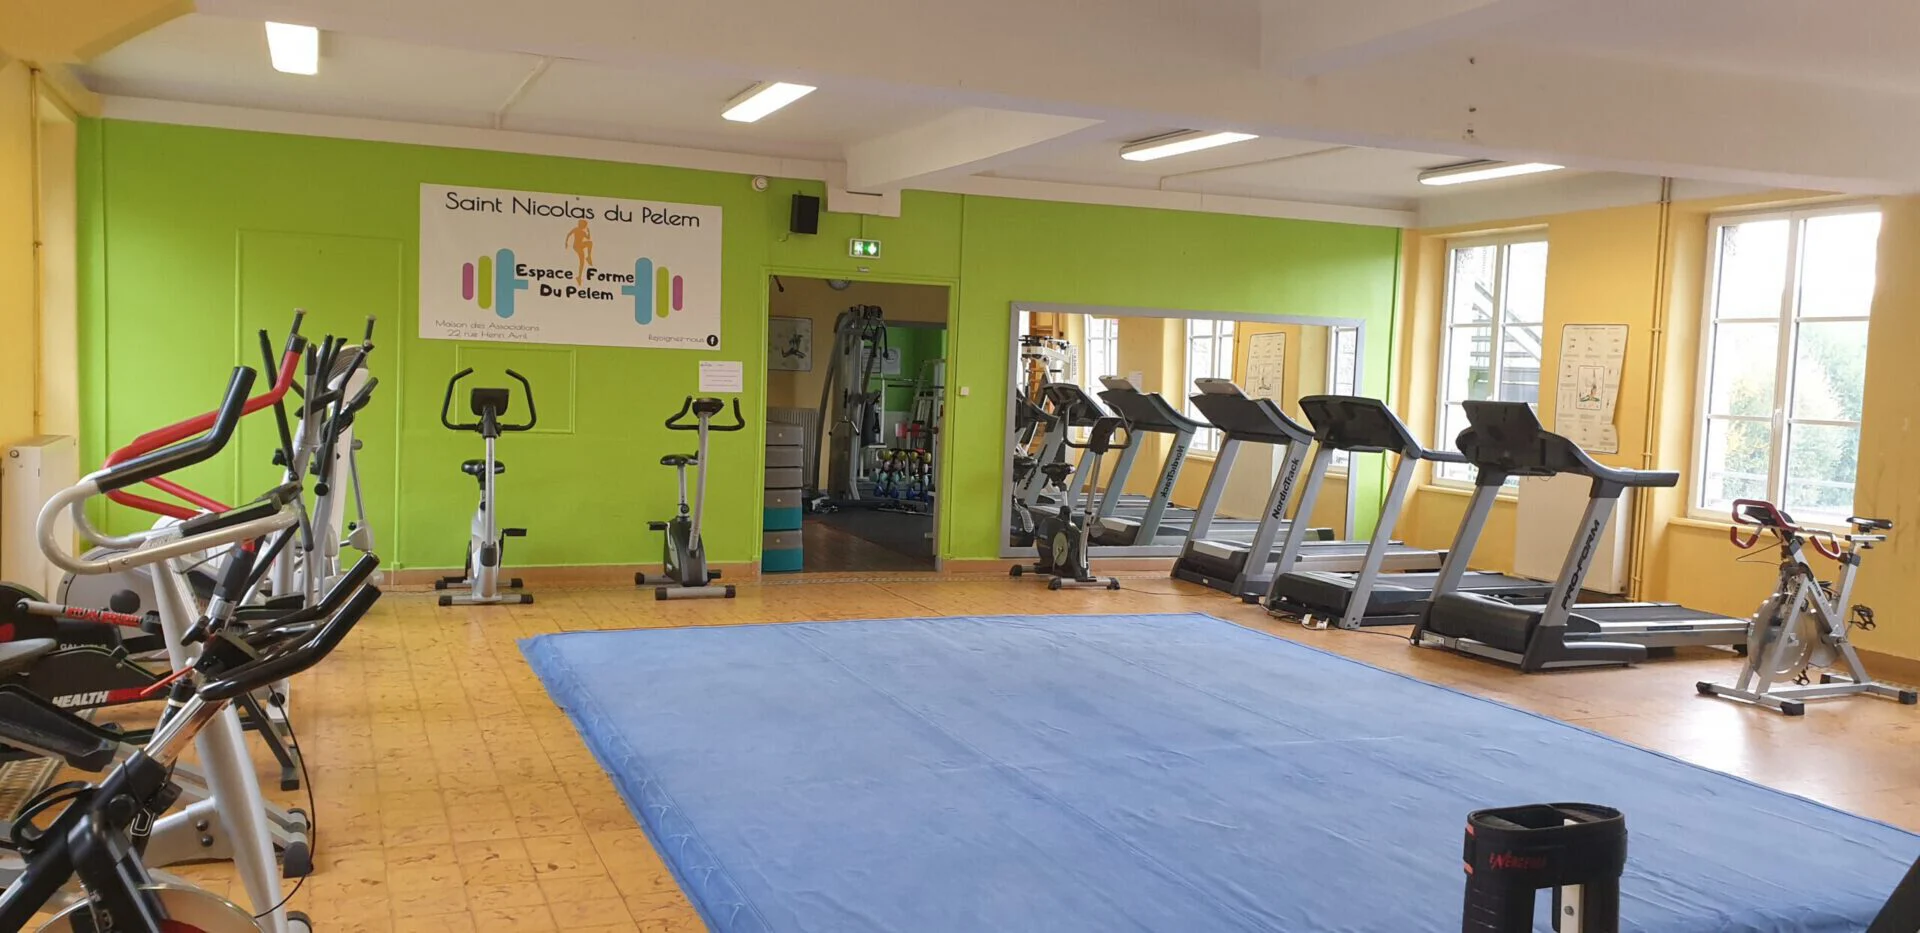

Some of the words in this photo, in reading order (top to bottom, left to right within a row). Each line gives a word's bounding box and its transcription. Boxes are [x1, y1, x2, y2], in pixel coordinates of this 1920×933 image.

[446, 191, 502, 213] Saint
[513, 196, 595, 219] Nicolas
[604, 204, 632, 222] du
[643, 206, 700, 227] Pelem
[515, 263, 573, 281] Espace
[586, 268, 634, 283] Forme
[540, 283, 562, 298] Du
[566, 286, 613, 300] Pelem
[435, 319, 468, 328] Maison
[471, 321, 486, 329] des
[489, 321, 540, 331] Associations
[447, 328, 461, 337] 22
[1271, 457, 1300, 520] NordicTrack
[52, 690, 110, 708] HEALTH
